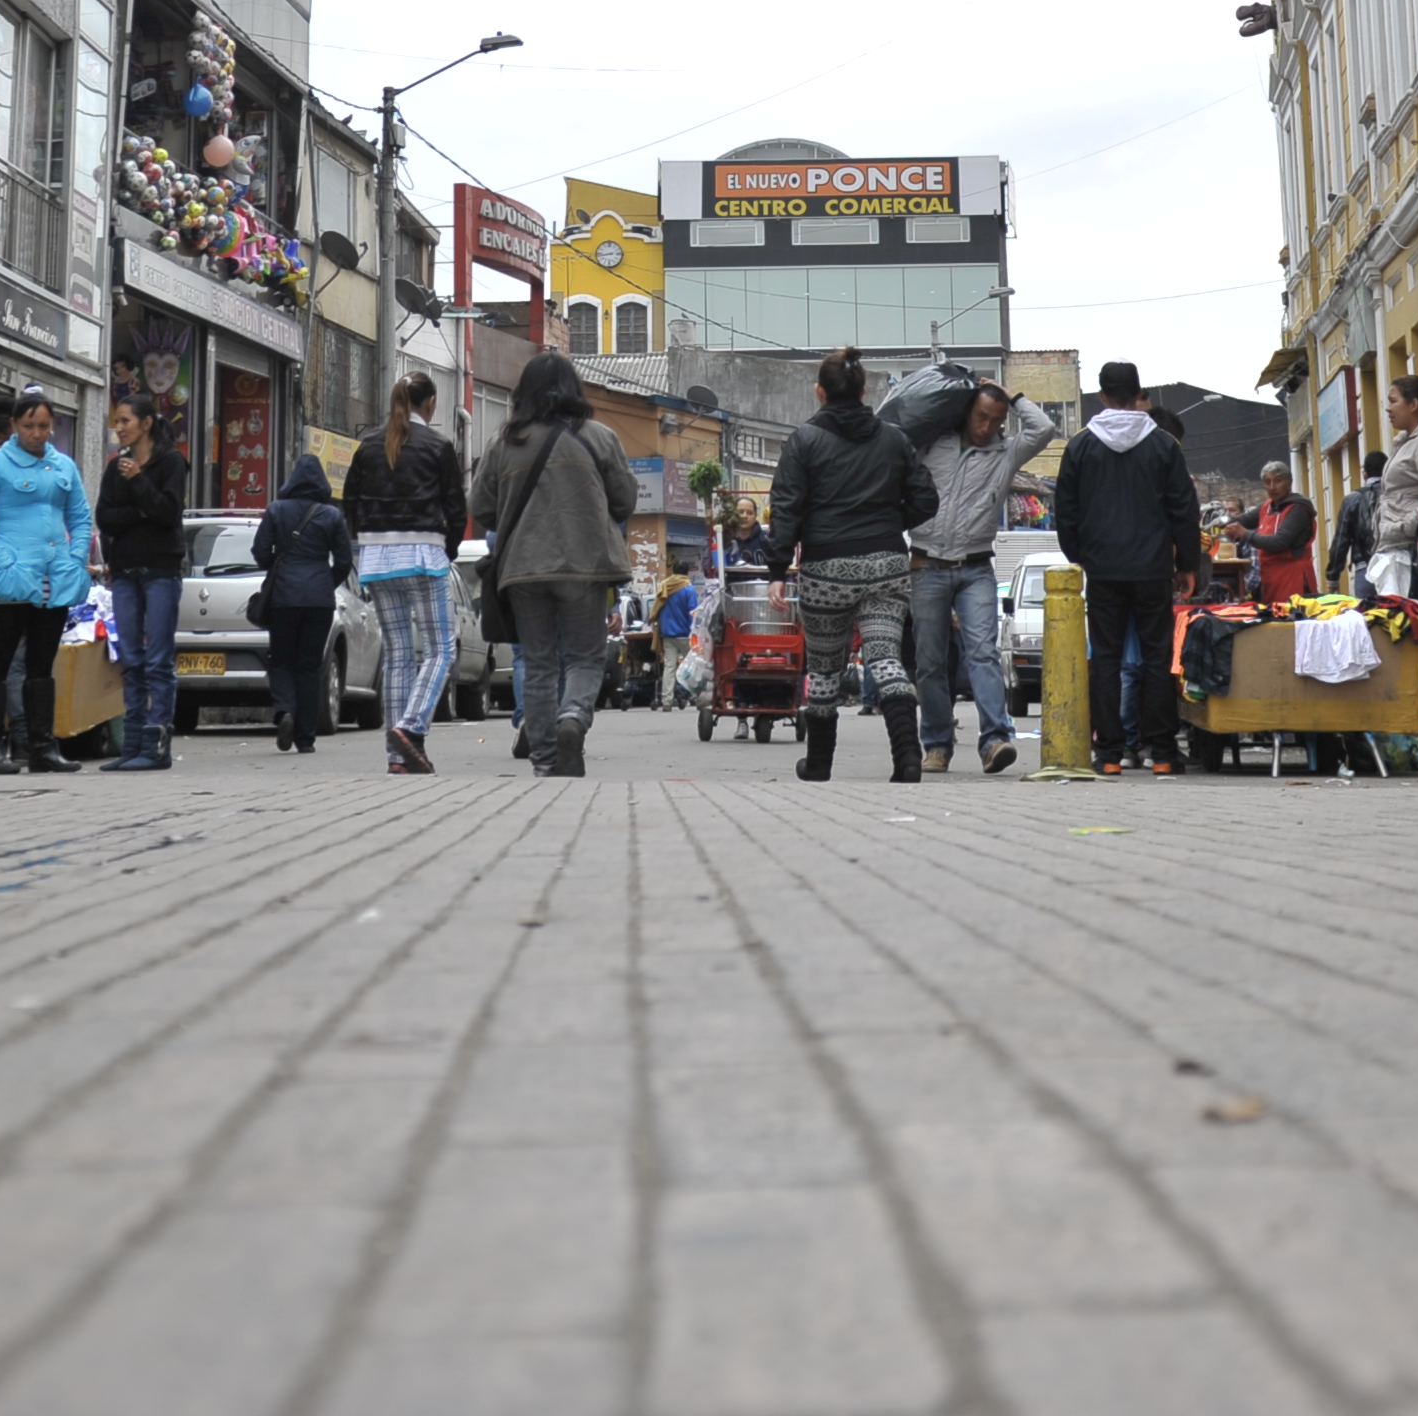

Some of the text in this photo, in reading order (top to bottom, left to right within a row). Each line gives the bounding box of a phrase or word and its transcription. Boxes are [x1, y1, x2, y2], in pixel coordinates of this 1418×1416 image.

[727, 165, 945, 193] EL NUEVO PONCE
[714, 197, 954, 217] CENTRO COMERCIAL
[479, 227, 538, 263] ENCAJES
[2, 299, 21, 332] San
[261, 311, 301, 355] CENTRAL
